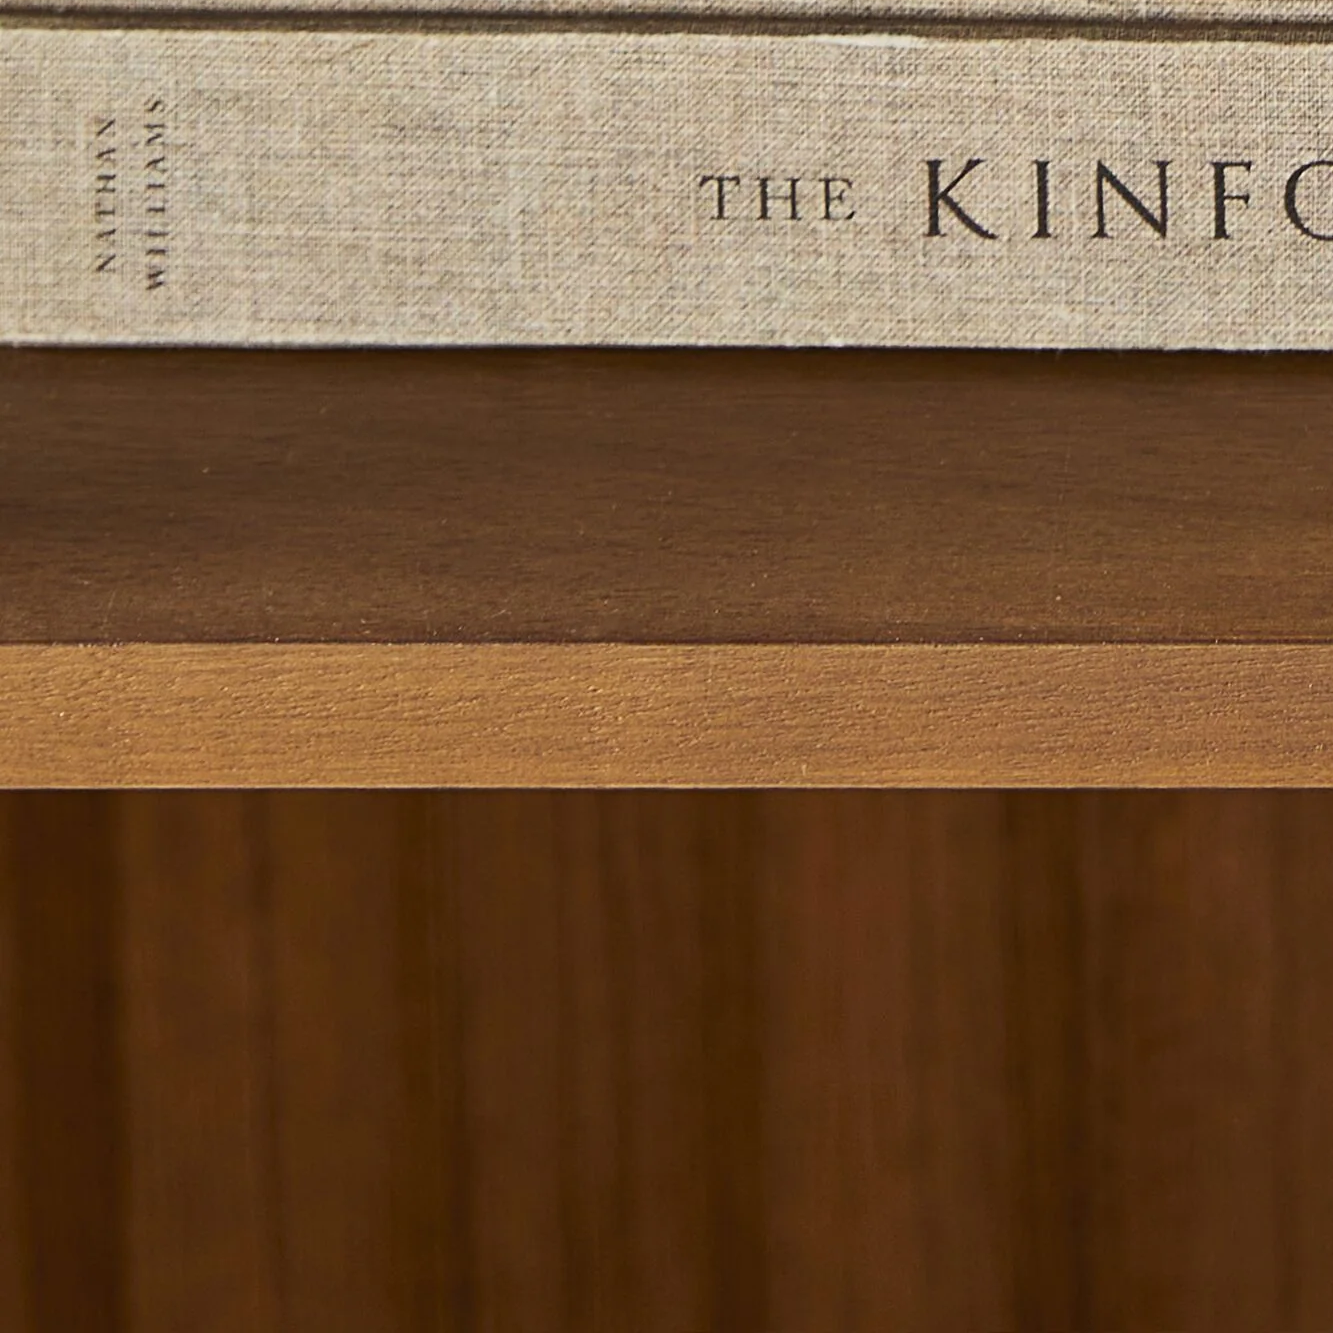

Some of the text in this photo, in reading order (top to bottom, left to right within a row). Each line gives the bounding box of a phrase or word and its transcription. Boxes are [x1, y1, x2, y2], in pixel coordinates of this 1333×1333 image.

[94, 115, 117, 273] NATHAN
[144, 96, 169, 291] WILLIAMS
[699, 174, 857, 223] THE
